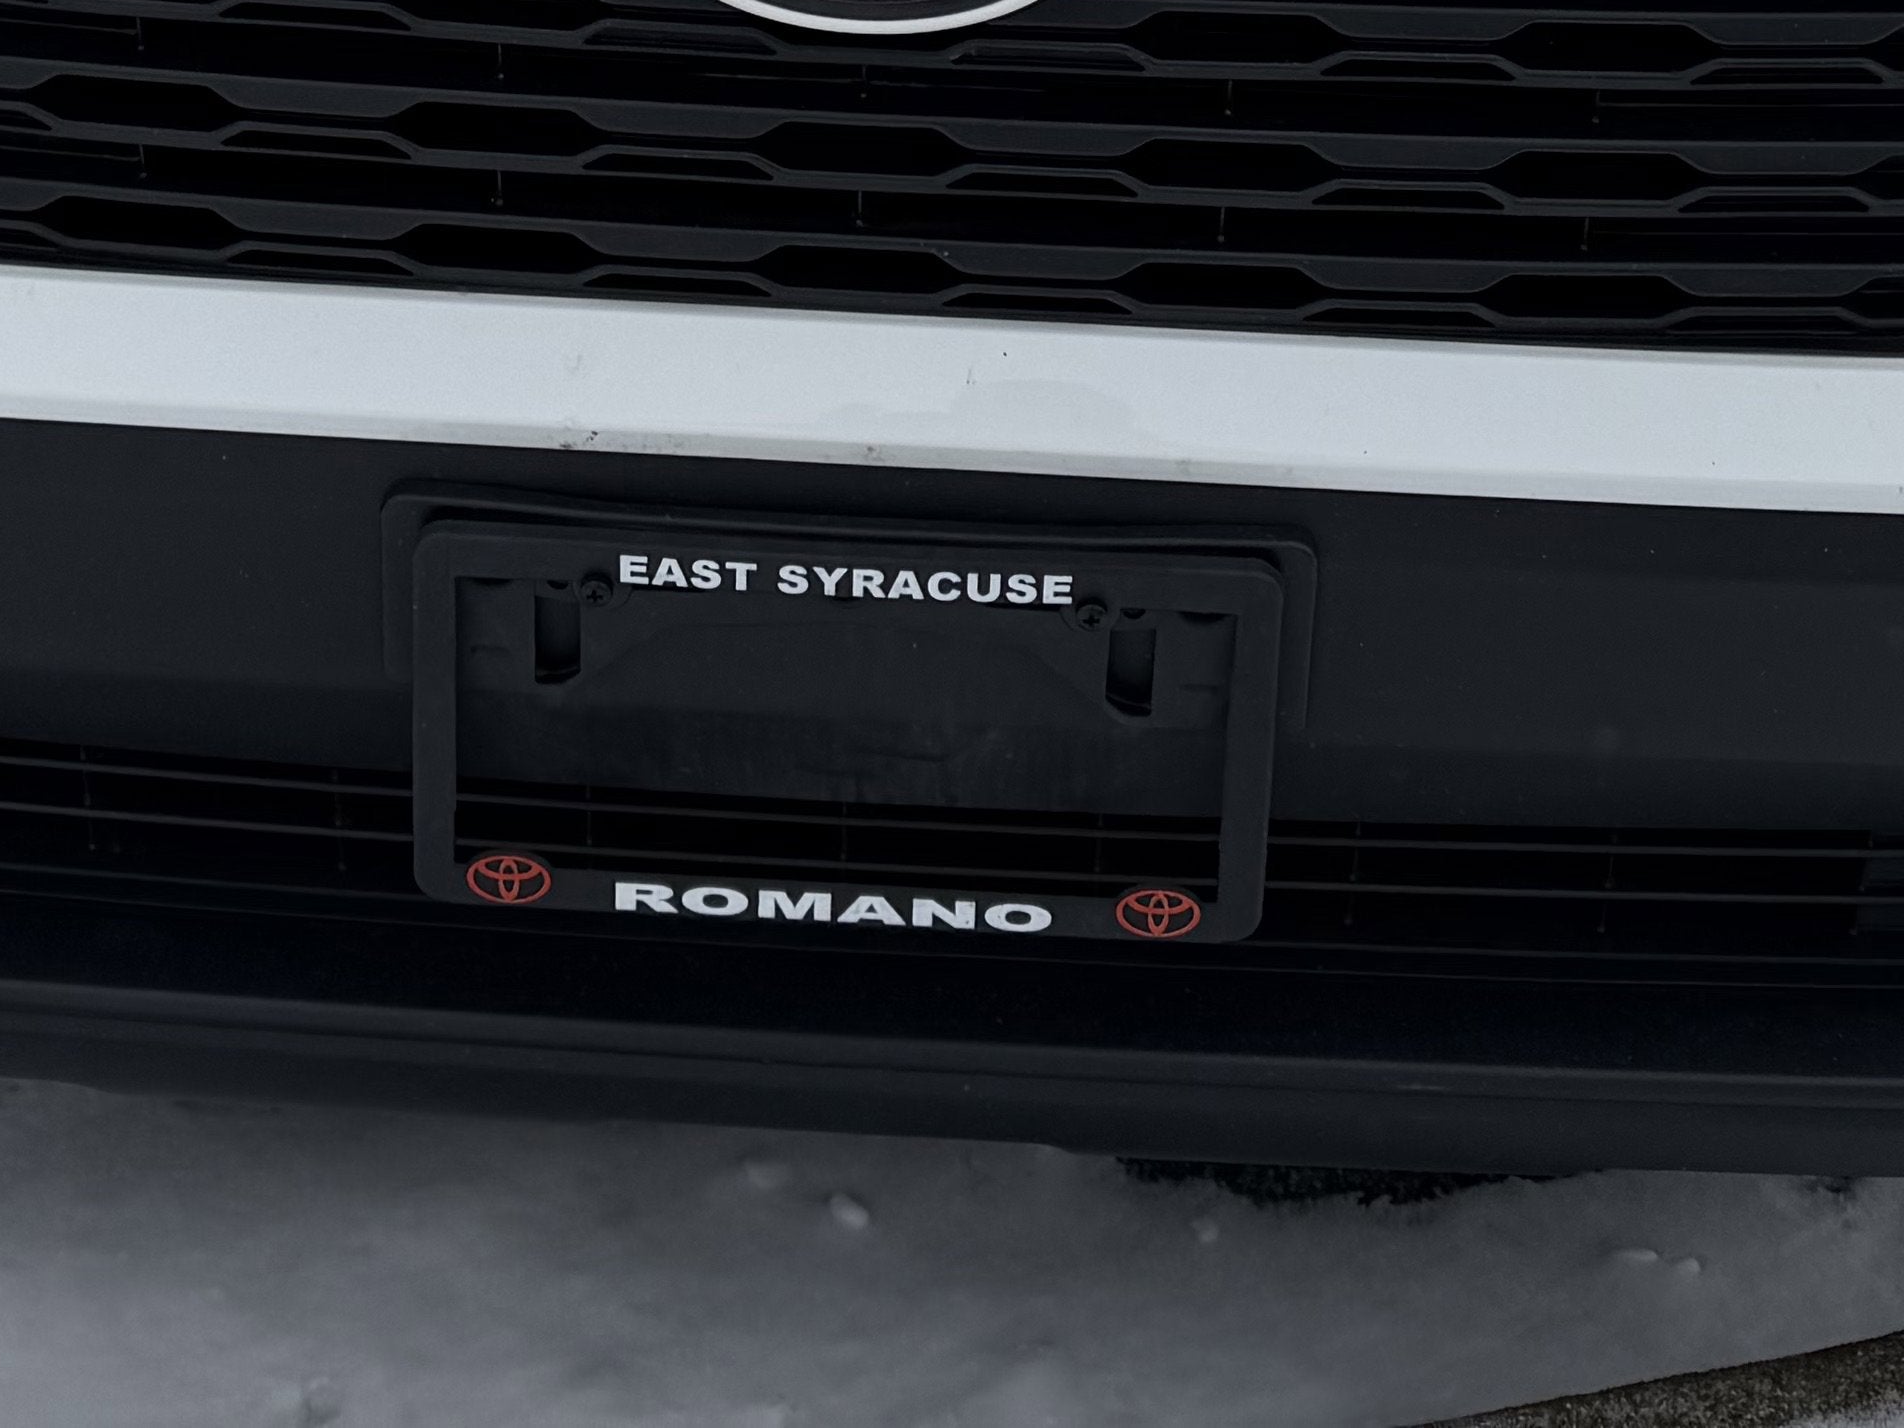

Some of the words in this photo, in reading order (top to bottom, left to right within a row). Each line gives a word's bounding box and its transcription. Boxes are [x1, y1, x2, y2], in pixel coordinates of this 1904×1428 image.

[619, 554, 757, 591] EAST
[777, 565, 1074, 605] SYRACUSE
[615, 882, 1052, 932] ROMANO
